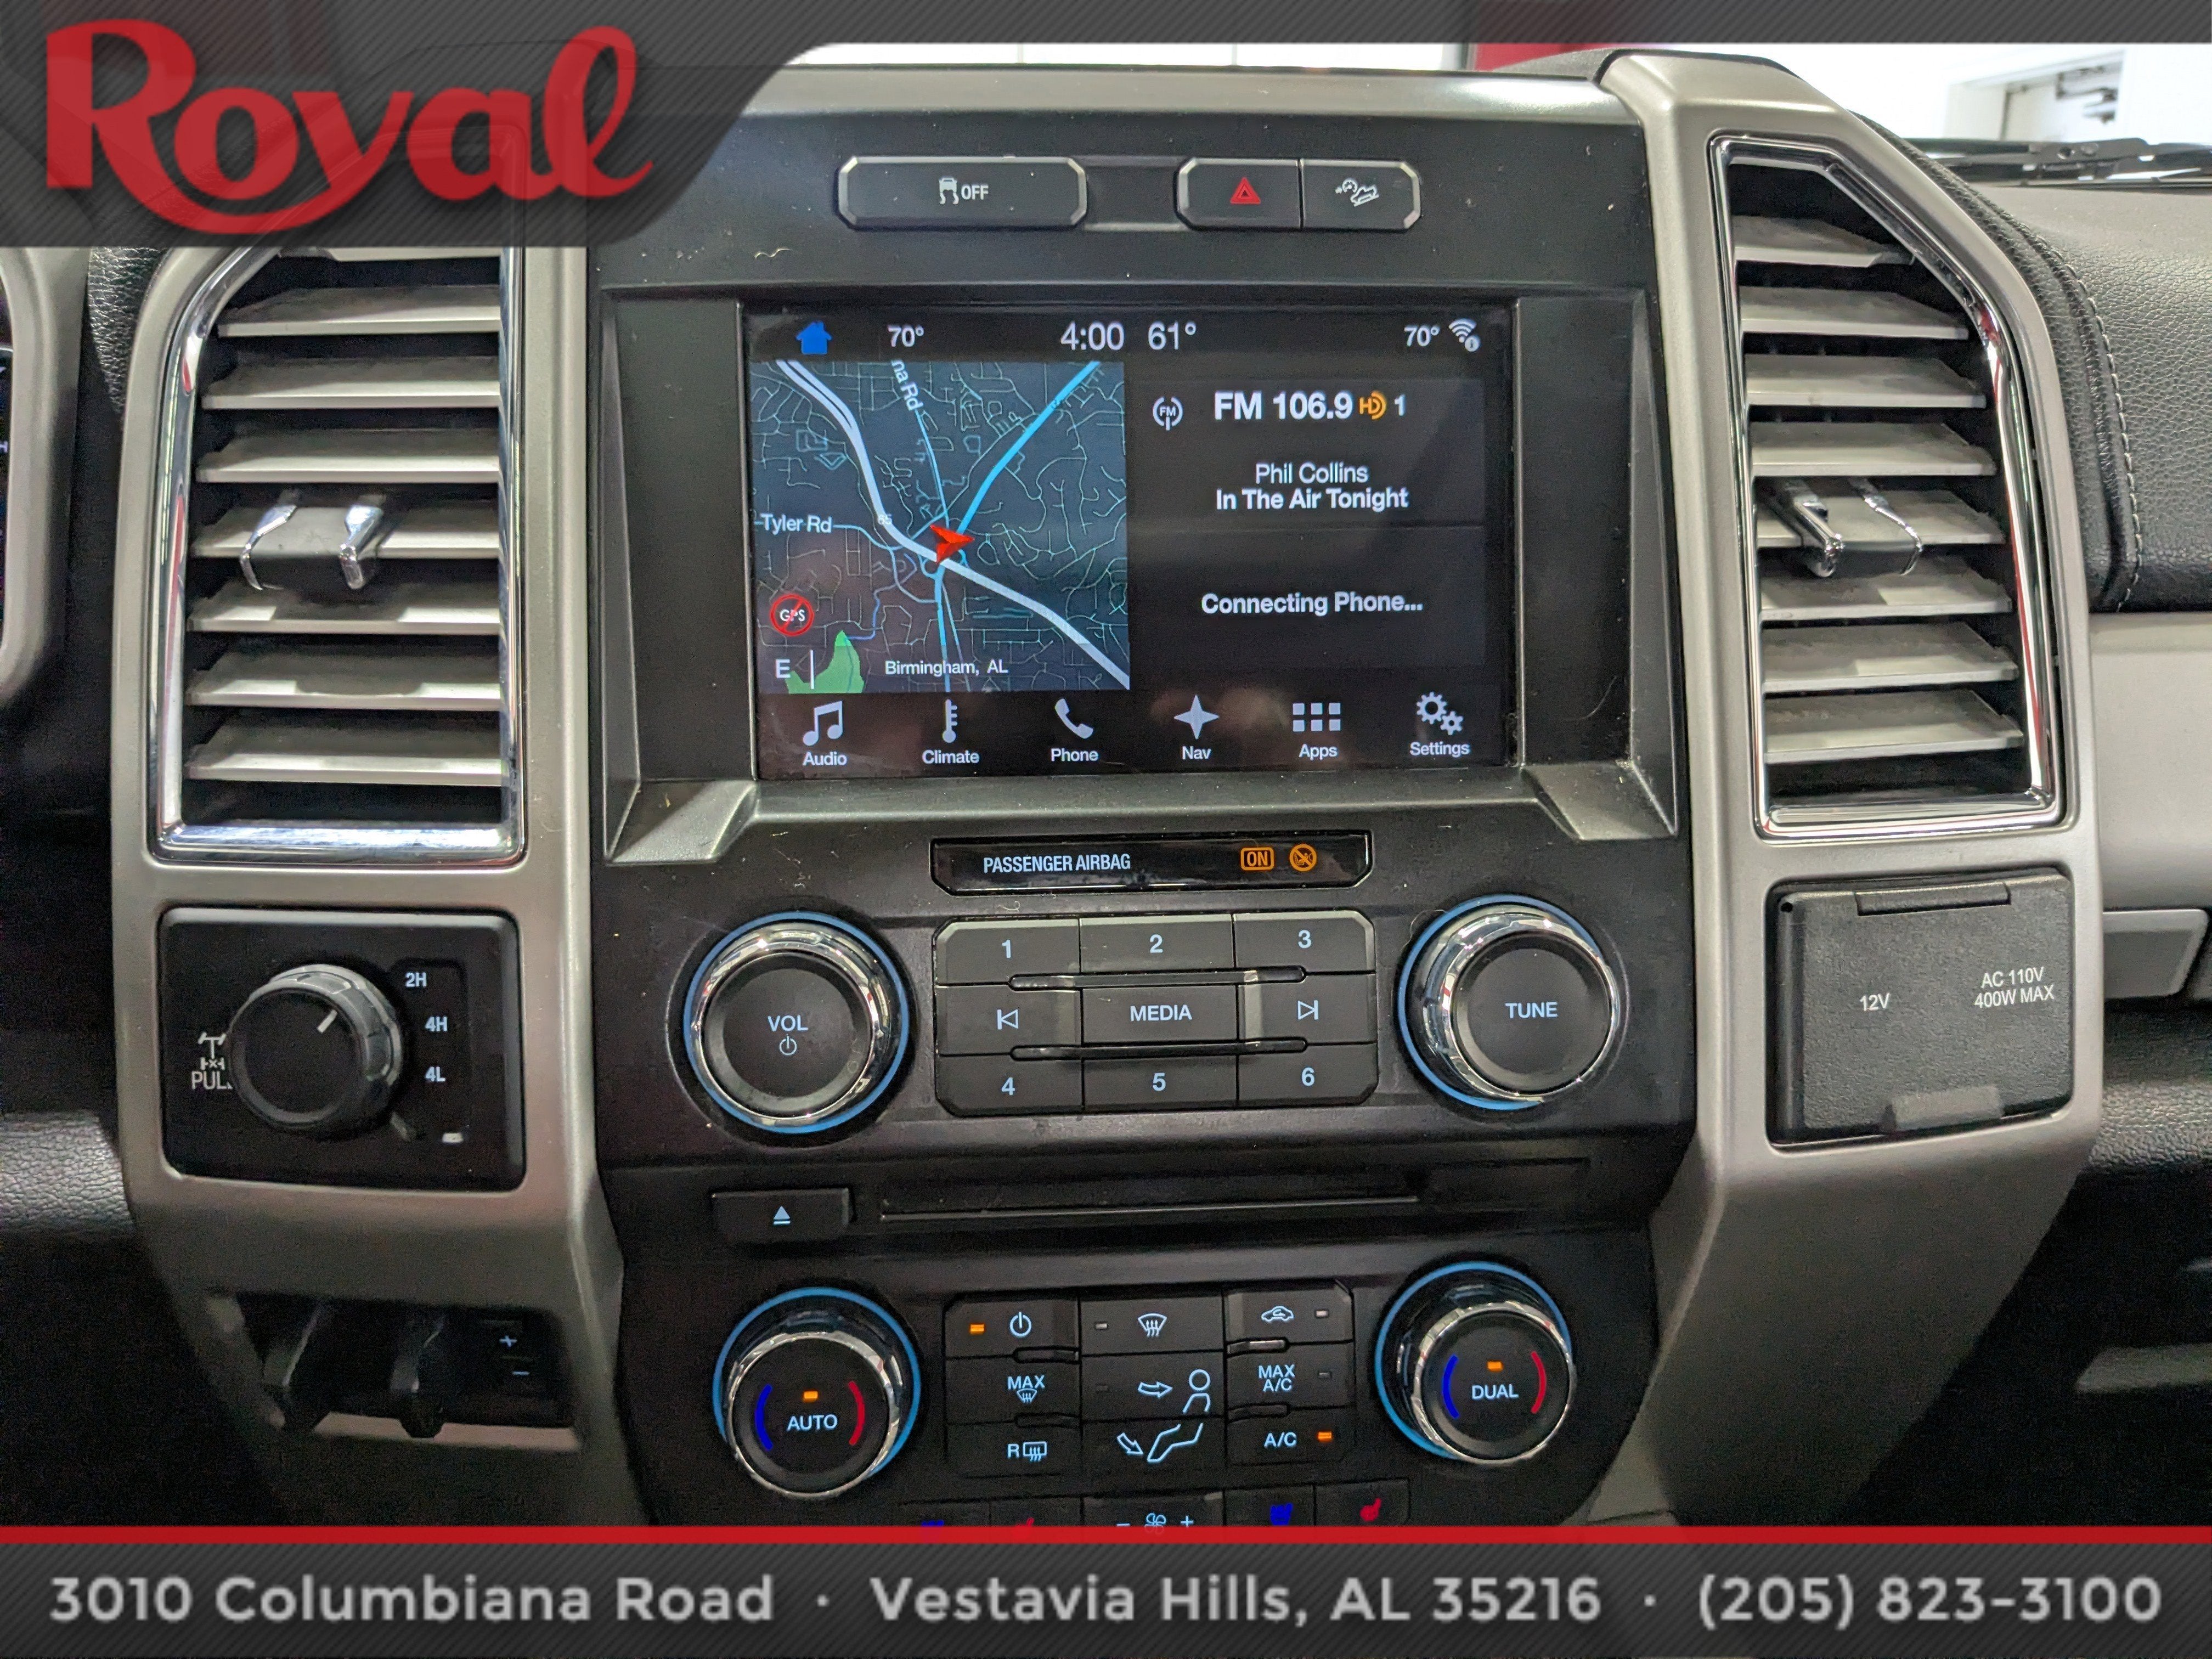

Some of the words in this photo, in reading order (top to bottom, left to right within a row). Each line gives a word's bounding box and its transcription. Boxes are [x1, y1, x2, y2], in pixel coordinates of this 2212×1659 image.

[961, 184, 989, 201] OFF
[1061, 321, 1125, 351] 4:00
[900, 382, 923, 411] Rd
[1214, 391, 1262, 420] FM
[1272, 390, 1353, 420] 106.9
[1394, 394, 1406, 416] 1
[1159, 405, 1177, 417] FM
[1255, 461, 1293, 484] Phil
[1299, 461, 1369, 484] Collins
[1216, 489, 1237, 510] In
[1242, 489, 1284, 509] The
[1289, 488, 1321, 509] Air
[1326, 486, 1409, 512] Tonight
[760, 513, 804, 535] Tyler
[807, 515, 832, 533] Rd
[1201, 593, 1328, 617] Connecting
[1334, 591, 1423, 612] Phone...
[780, 609, 805, 623] GPS
[775, 659, 791, 679] E
[885, 660, 979, 678] Birmingham,
[987, 659, 1009, 673] AL
[803, 751, 848, 766] Audio
[922, 749, 980, 765] Climate
[1051, 747, 1099, 762] Phone
[1182, 747, 1211, 760] Nav
[1298, 744, 1338, 760] Apps
[1409, 741, 1470, 758] Settings
[983, 855, 1073, 874] PASSENGER
[1076, 854, 1131, 870] AIRBAG
[1246, 851, 1268, 866] ON
[1149, 934, 1164, 953] 2
[1297, 929, 1312, 949] 3
[1002, 939, 1012, 959] 1
[405, 972, 427, 988] 2H
[1981, 972, 2004, 989] AC
[2008, 967, 2045, 986] 110V
[1859, 992, 1891, 1012] 12V
[1974, 989, 2018, 1008] 400W
[2019, 984, 2055, 1003] MAX
[1130, 1003, 1192, 1022] MEDIA
[1505, 1001, 1559, 1019] TUNE
[425, 1017, 448, 1032] 4H
[768, 1014, 809, 1032] VOL
[191, 1070, 233, 1090] PUL
[425, 1066, 446, 1082] 4L
[1152, 1073, 1166, 1091] 5
[1301, 1067, 1315, 1086] 6
[1001, 1077, 1015, 1096] 4
[1257, 1363, 1295, 1380] MAX
[1007, 1375, 1046, 1390] MAX
[1262, 1378, 1293, 1392] A/C
[1471, 1384, 1519, 1400] DUAL
[786, 1414, 838, 1432] AUTO
[1263, 1431, 1297, 1448] A/C
[1007, 1443, 1019, 1458] R
